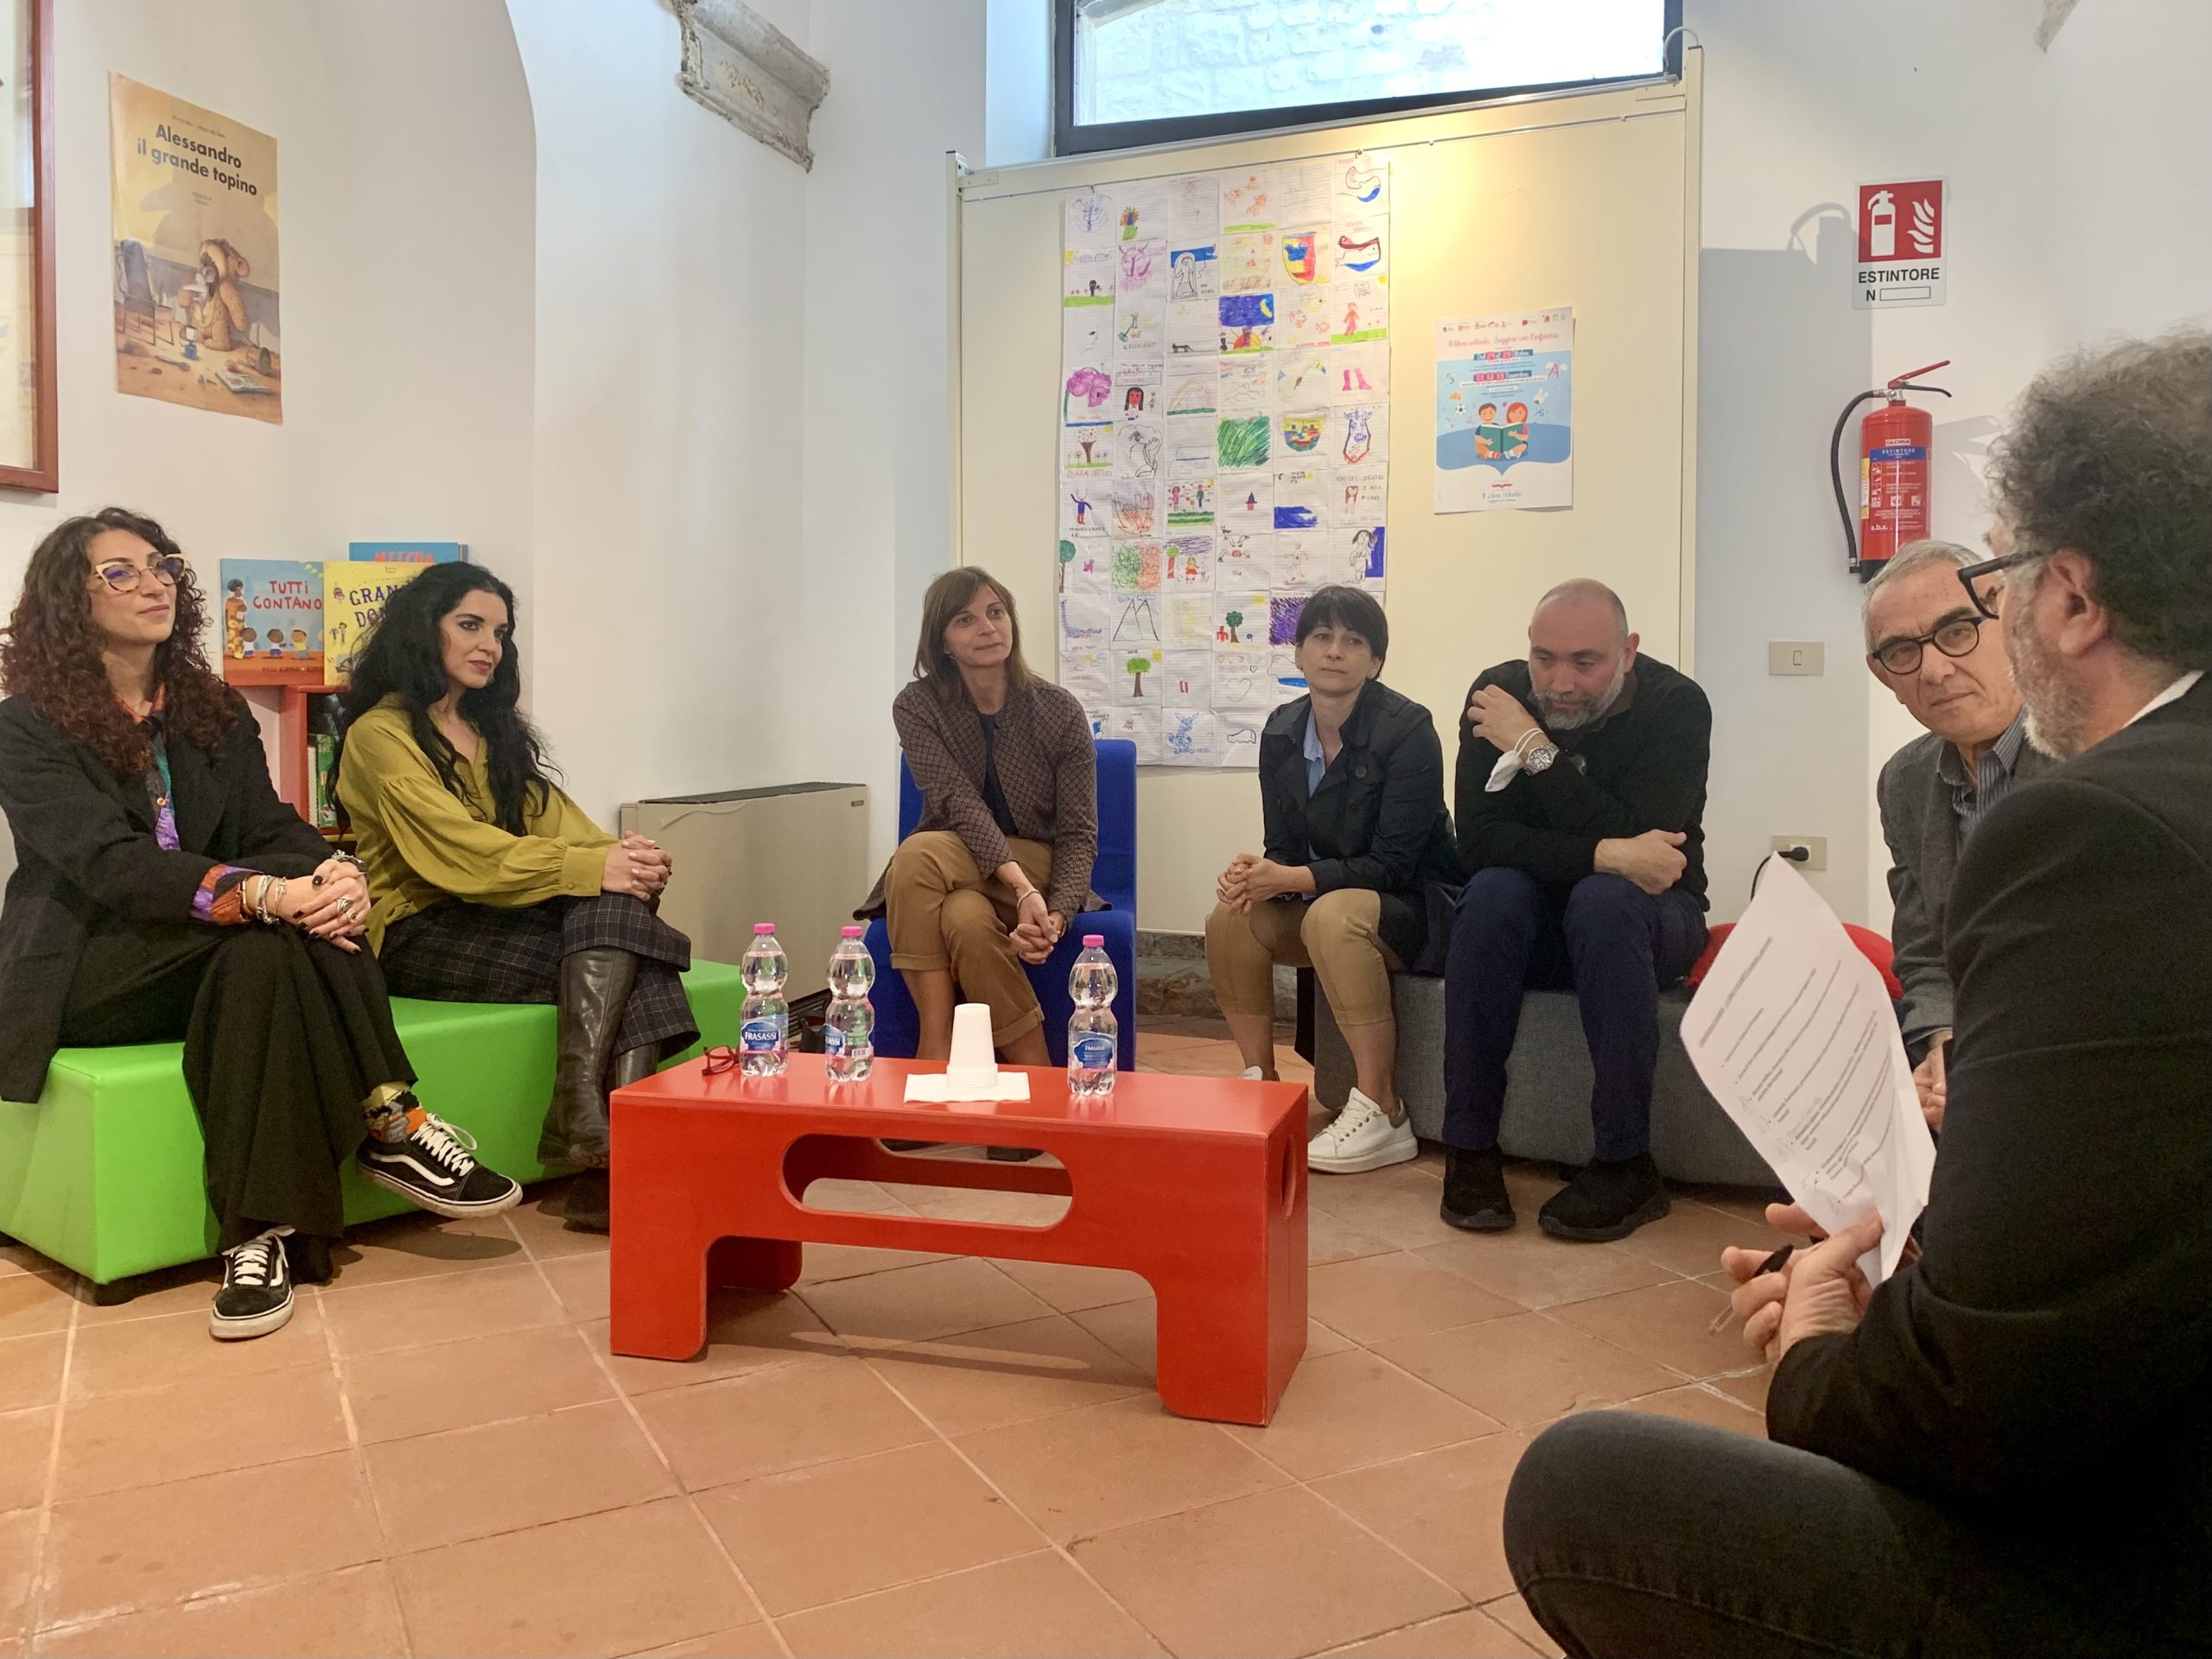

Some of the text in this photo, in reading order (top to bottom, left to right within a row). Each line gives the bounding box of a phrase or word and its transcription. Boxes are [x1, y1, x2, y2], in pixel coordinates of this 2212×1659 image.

[156, 124, 242, 168] Alessandro
[137, 137, 257, 195] il grande topino
[1858, 267, 1940, 283] ESTINTORE
[1866, 289, 1876, 302] N
[252, 594, 322, 610] CONTANO
[349, 584, 399, 607] GRAN
[744, 1031, 778, 1041] FRASASSI
